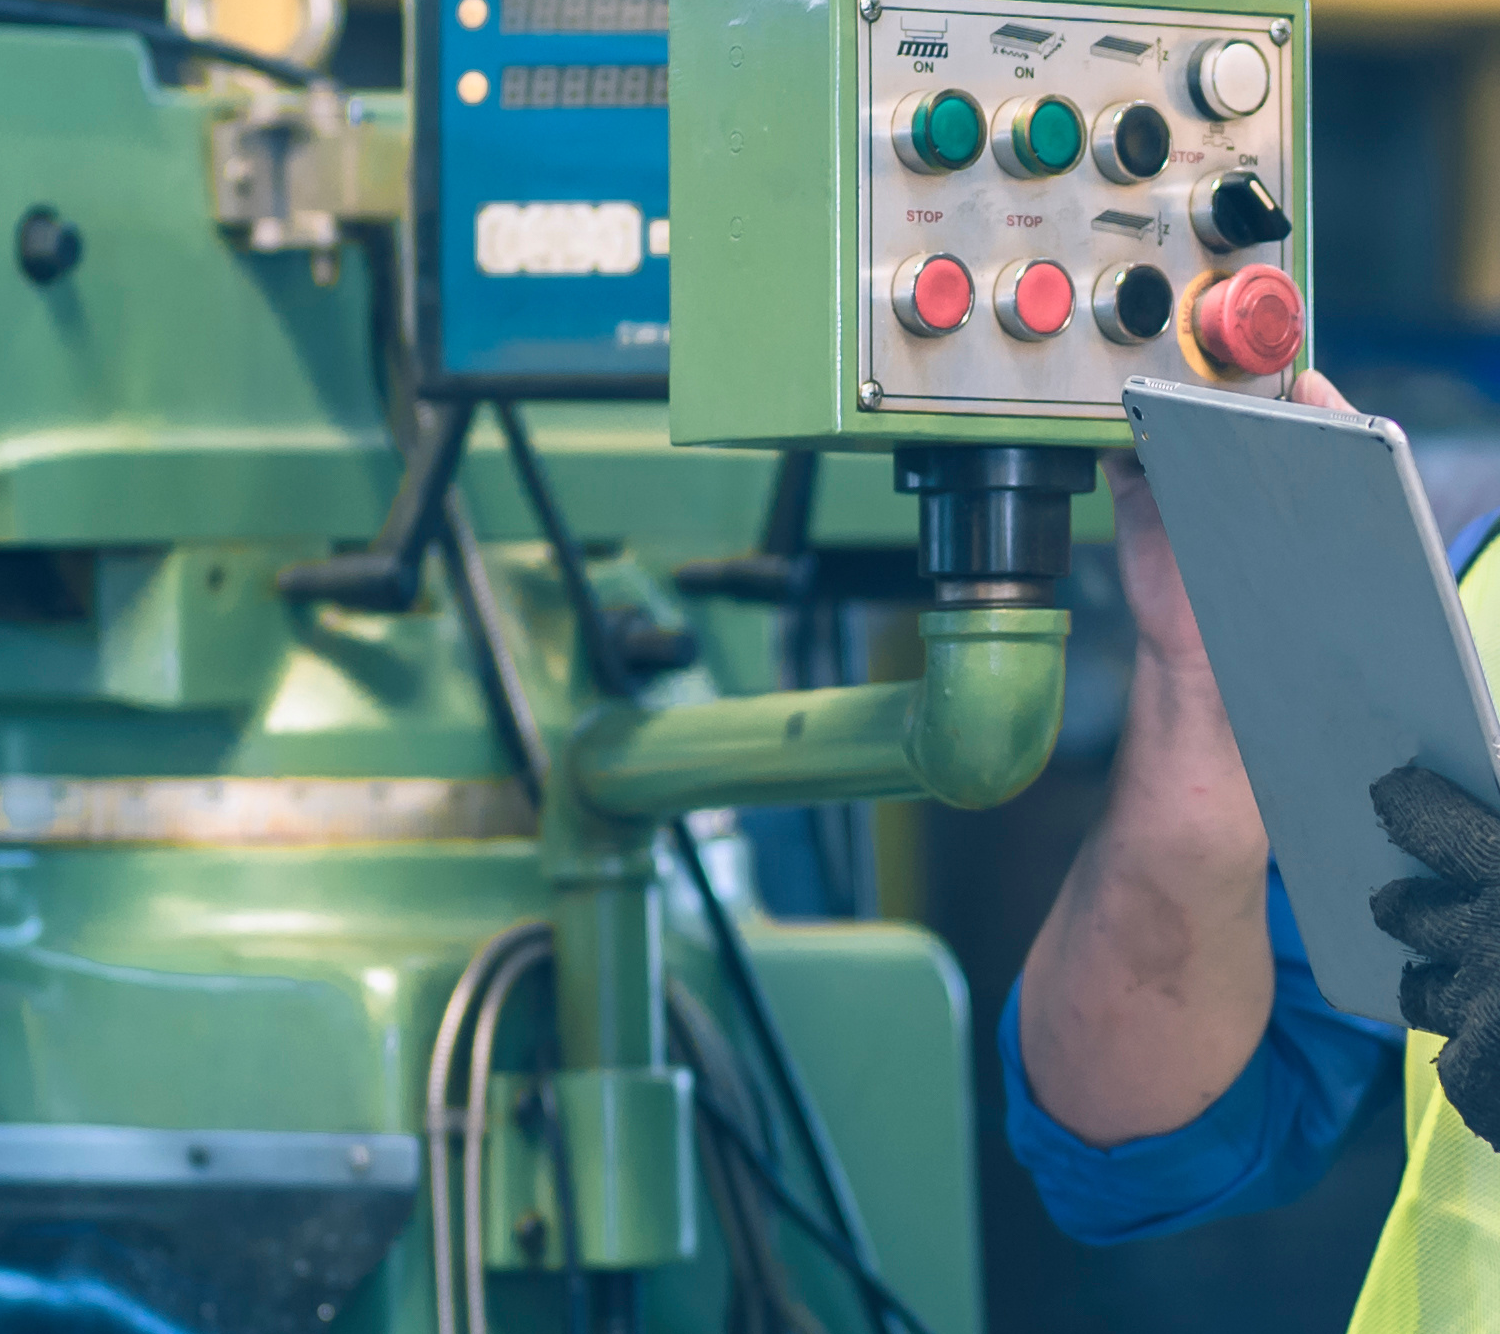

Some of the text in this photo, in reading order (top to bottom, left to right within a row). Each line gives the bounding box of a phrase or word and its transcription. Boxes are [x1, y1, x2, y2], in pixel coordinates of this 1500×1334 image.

[992, 46, 998, 55] X
[1163, 50, 1169, 61] Z
[913, 60, 934, 73] ON
[1014, 67, 1035, 79] ON
[1171, 151, 1204, 164] STOP
[1239, 154, 1258, 166] ON
[906, 209, 944, 224] STOP
[1006, 214, 1043, 228] STOP
